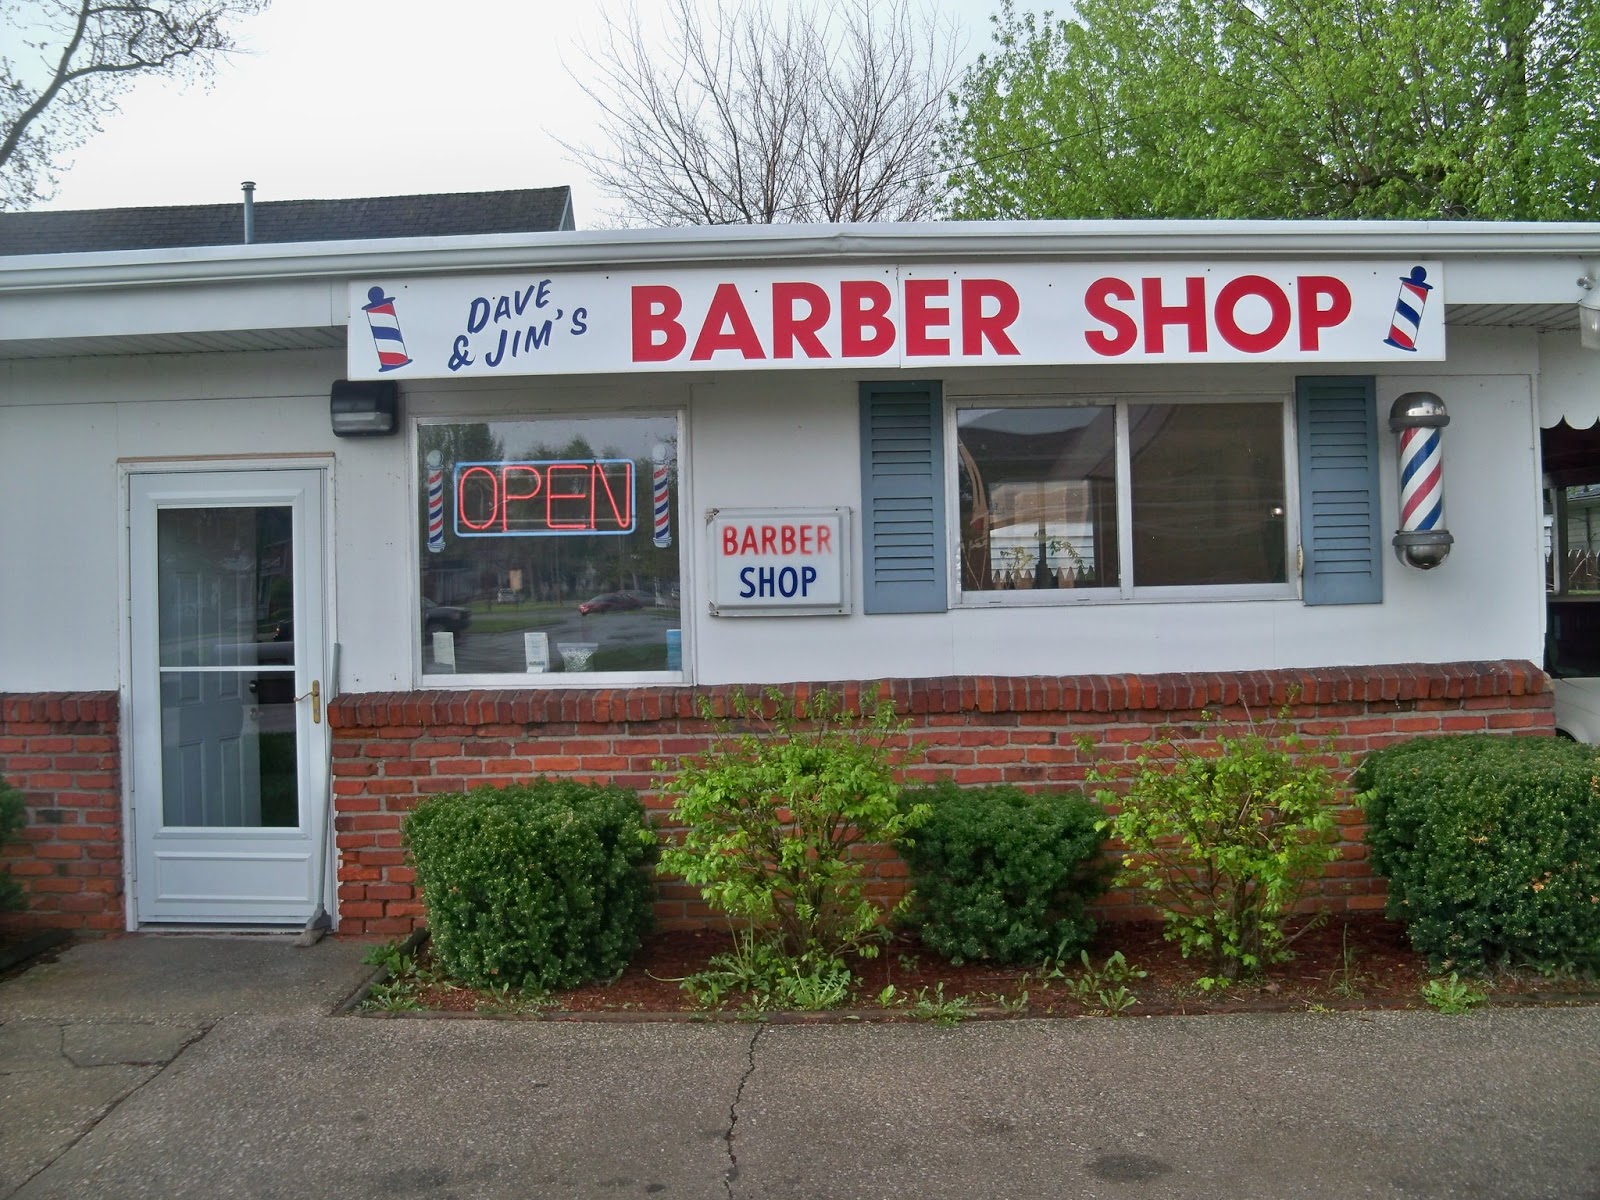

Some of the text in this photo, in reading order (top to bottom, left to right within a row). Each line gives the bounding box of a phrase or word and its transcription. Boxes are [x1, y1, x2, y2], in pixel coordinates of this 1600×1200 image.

[467, 279, 552, 334] DAVE
[631, 275, 1352, 362] BARBER SHOP
[448, 307, 588, 371] & JIM'S
[459, 463, 631, 530] OPEN
[722, 525, 833, 556] BARBER
[739, 566, 817, 598] SHOP
